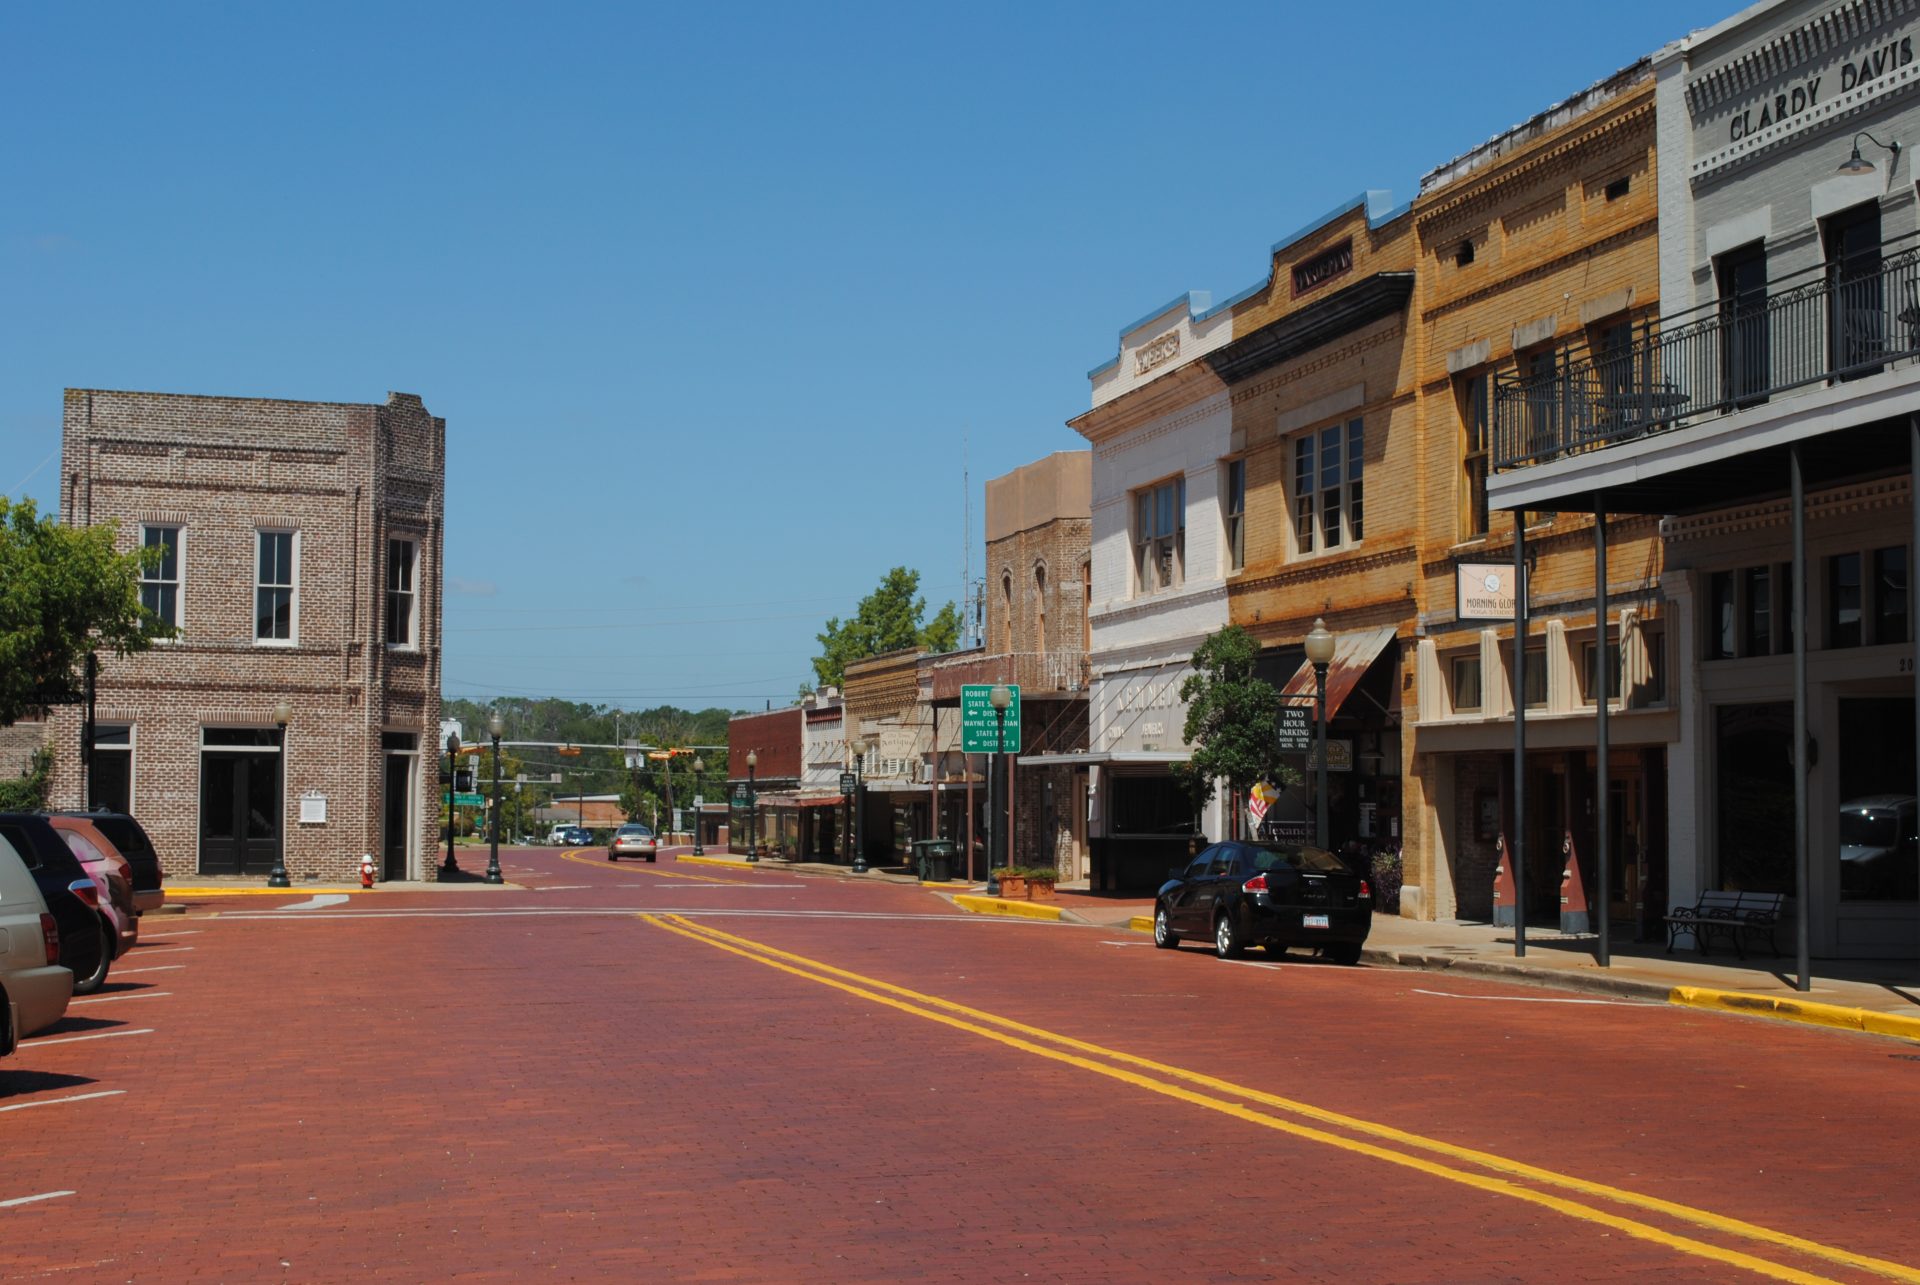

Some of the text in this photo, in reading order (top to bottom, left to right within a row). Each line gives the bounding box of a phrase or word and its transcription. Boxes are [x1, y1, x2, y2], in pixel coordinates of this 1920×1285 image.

[1730, 35, 1913, 142] CLARDY DAVIS
[1466, 598, 1496, 609] MORNING
[968, 700, 985, 708] STATE
[1285, 710, 1304, 718] TWO
[1283, 719, 1306, 728] HOUR
[1279, 728, 1309, 736] PARKING
